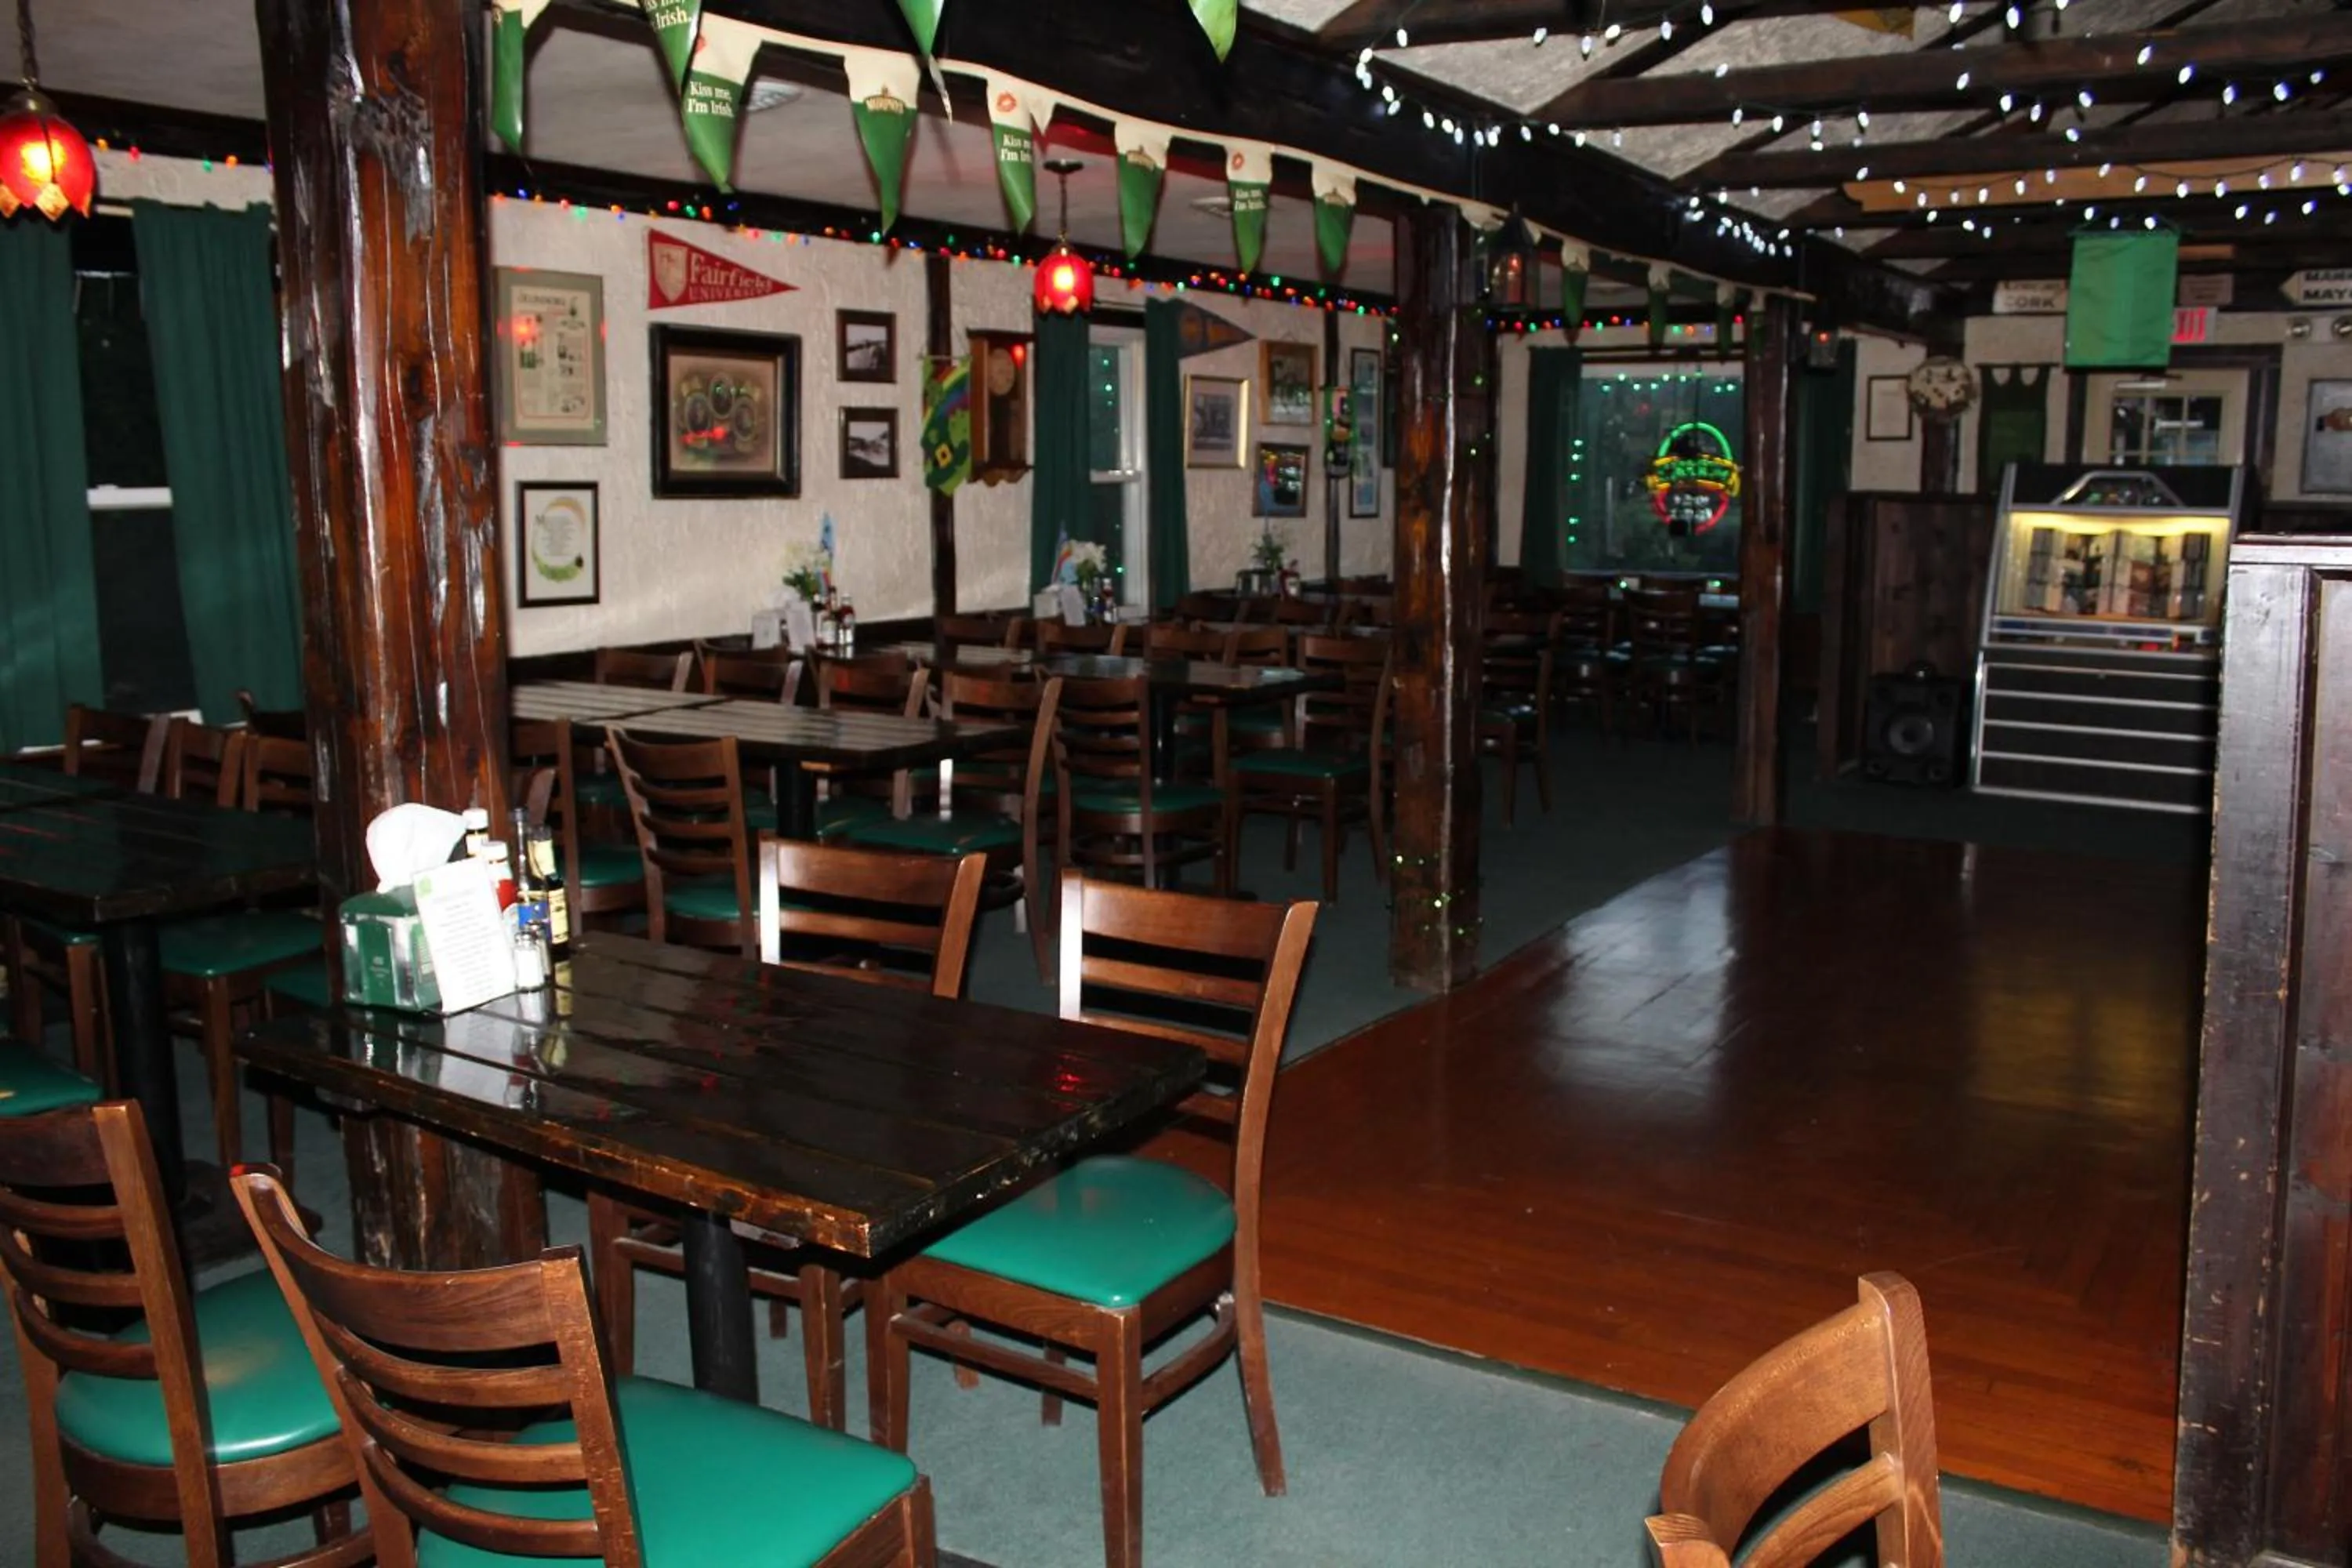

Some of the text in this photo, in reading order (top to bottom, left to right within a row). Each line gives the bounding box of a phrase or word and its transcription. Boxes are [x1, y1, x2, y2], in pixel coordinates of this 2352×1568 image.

[654, 6, 693, 29] Irish.
[690, 81, 732, 101] Kiss me,
[687, 98, 709, 113] I'm
[1000, 148, 1018, 162] I'm
[689, 252, 773, 289] Fairfield
[688, 283, 773, 301] UNIVERSITY
[2303, 288, 2352, 301] MAY
